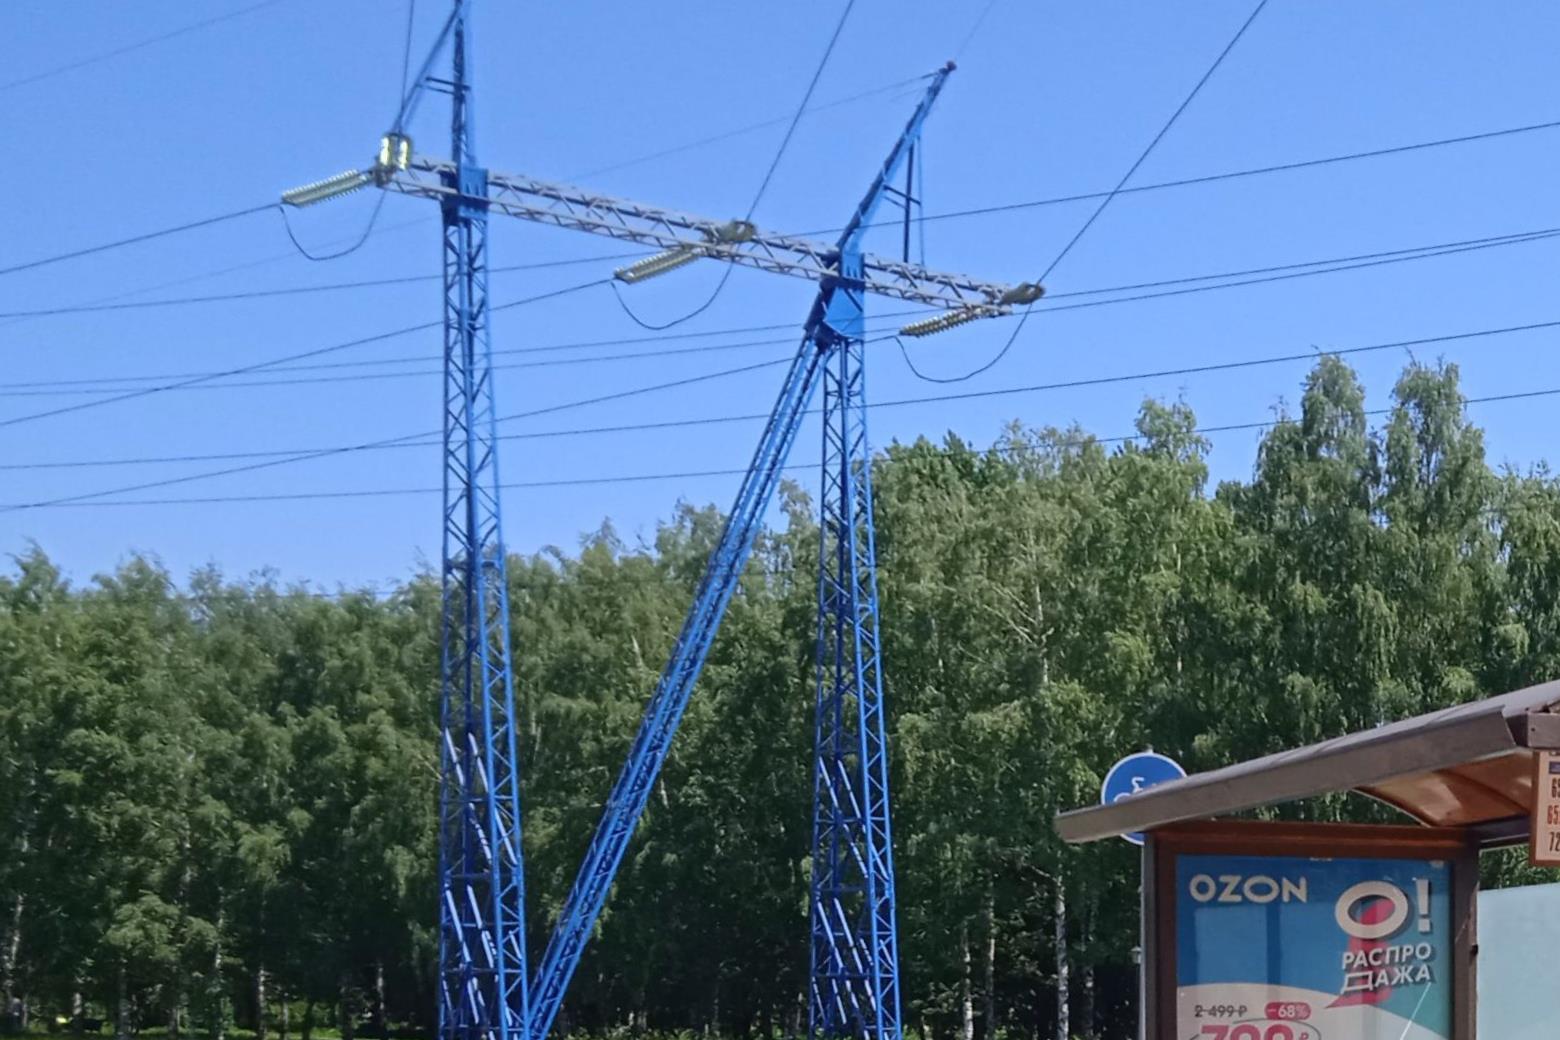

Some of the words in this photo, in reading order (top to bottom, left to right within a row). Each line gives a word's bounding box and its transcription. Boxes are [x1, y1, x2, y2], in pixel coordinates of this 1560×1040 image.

[1549, 832, 1560, 852] 72
[1189, 874, 1307, 904] OZON
[1342, 942, 1432, 970] РАСПРО
[1340, 963, 1431, 994] ДАЖА
